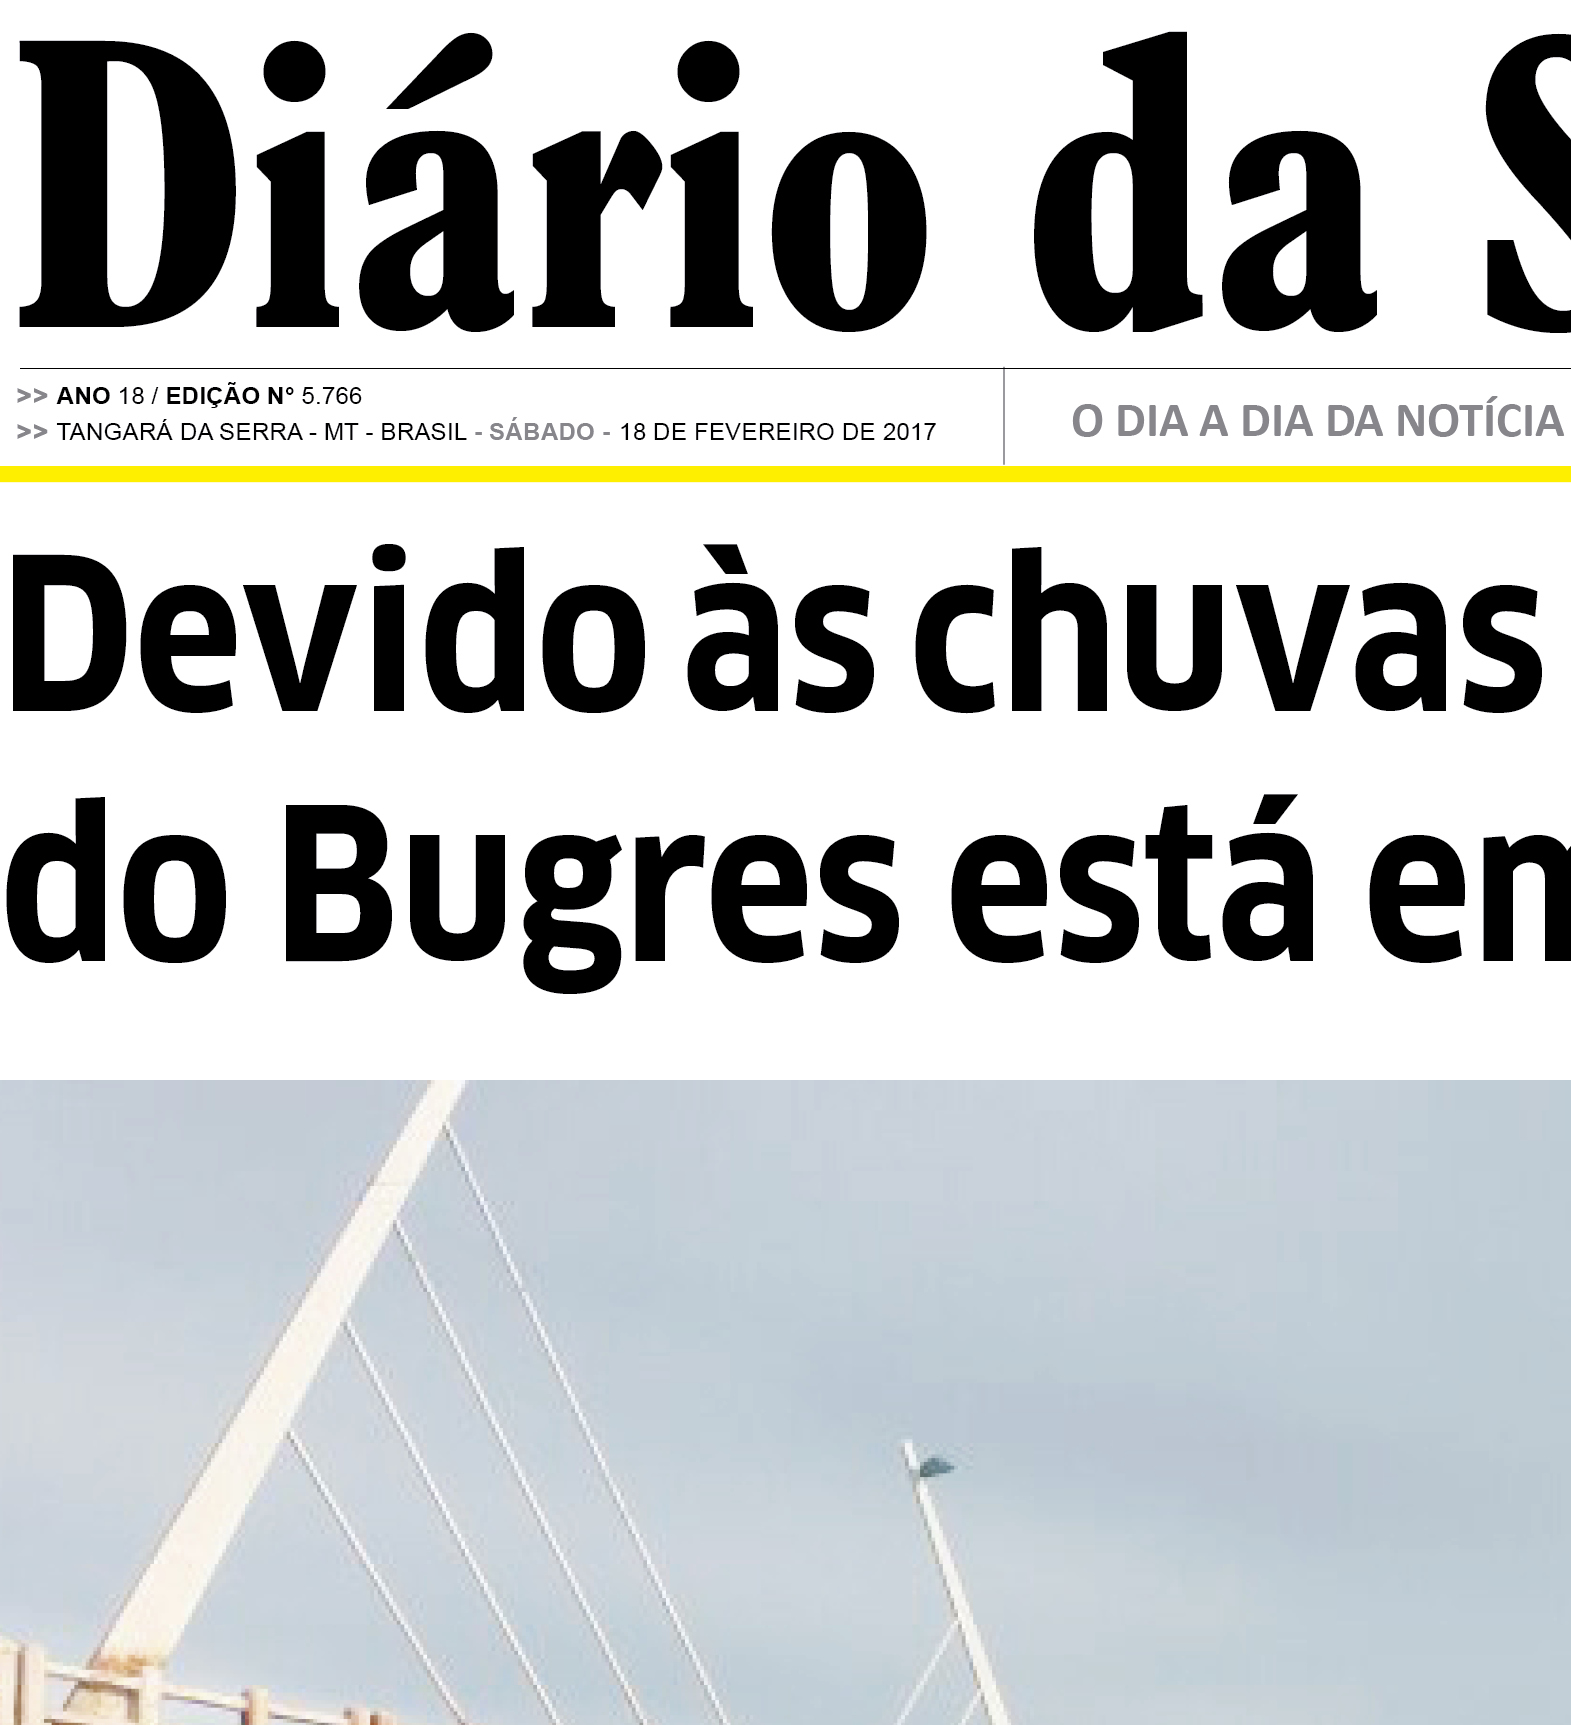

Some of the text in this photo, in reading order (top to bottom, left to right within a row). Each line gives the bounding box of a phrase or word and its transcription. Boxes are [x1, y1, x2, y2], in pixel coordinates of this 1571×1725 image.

[18, 32, 928, 333] Diário
[1033, 31, 1378, 333] da
[56, 416, 937, 441] TANGARÁ DA SERRA MT BRASIL SÁBADO 18 DE FEVEREIRO DE 2017
[1072, 395, 1565, 438] O DIA A DIA DA NOTÍCIA
[12, 543, 646, 714] Devido
[686, 543, 875, 714] às
[914, 546, 1543, 714] chuvas
[5, 796, 227, 964] do
[285, 804, 900, 995] Bugres
[950, 793, 1314, 964] está
